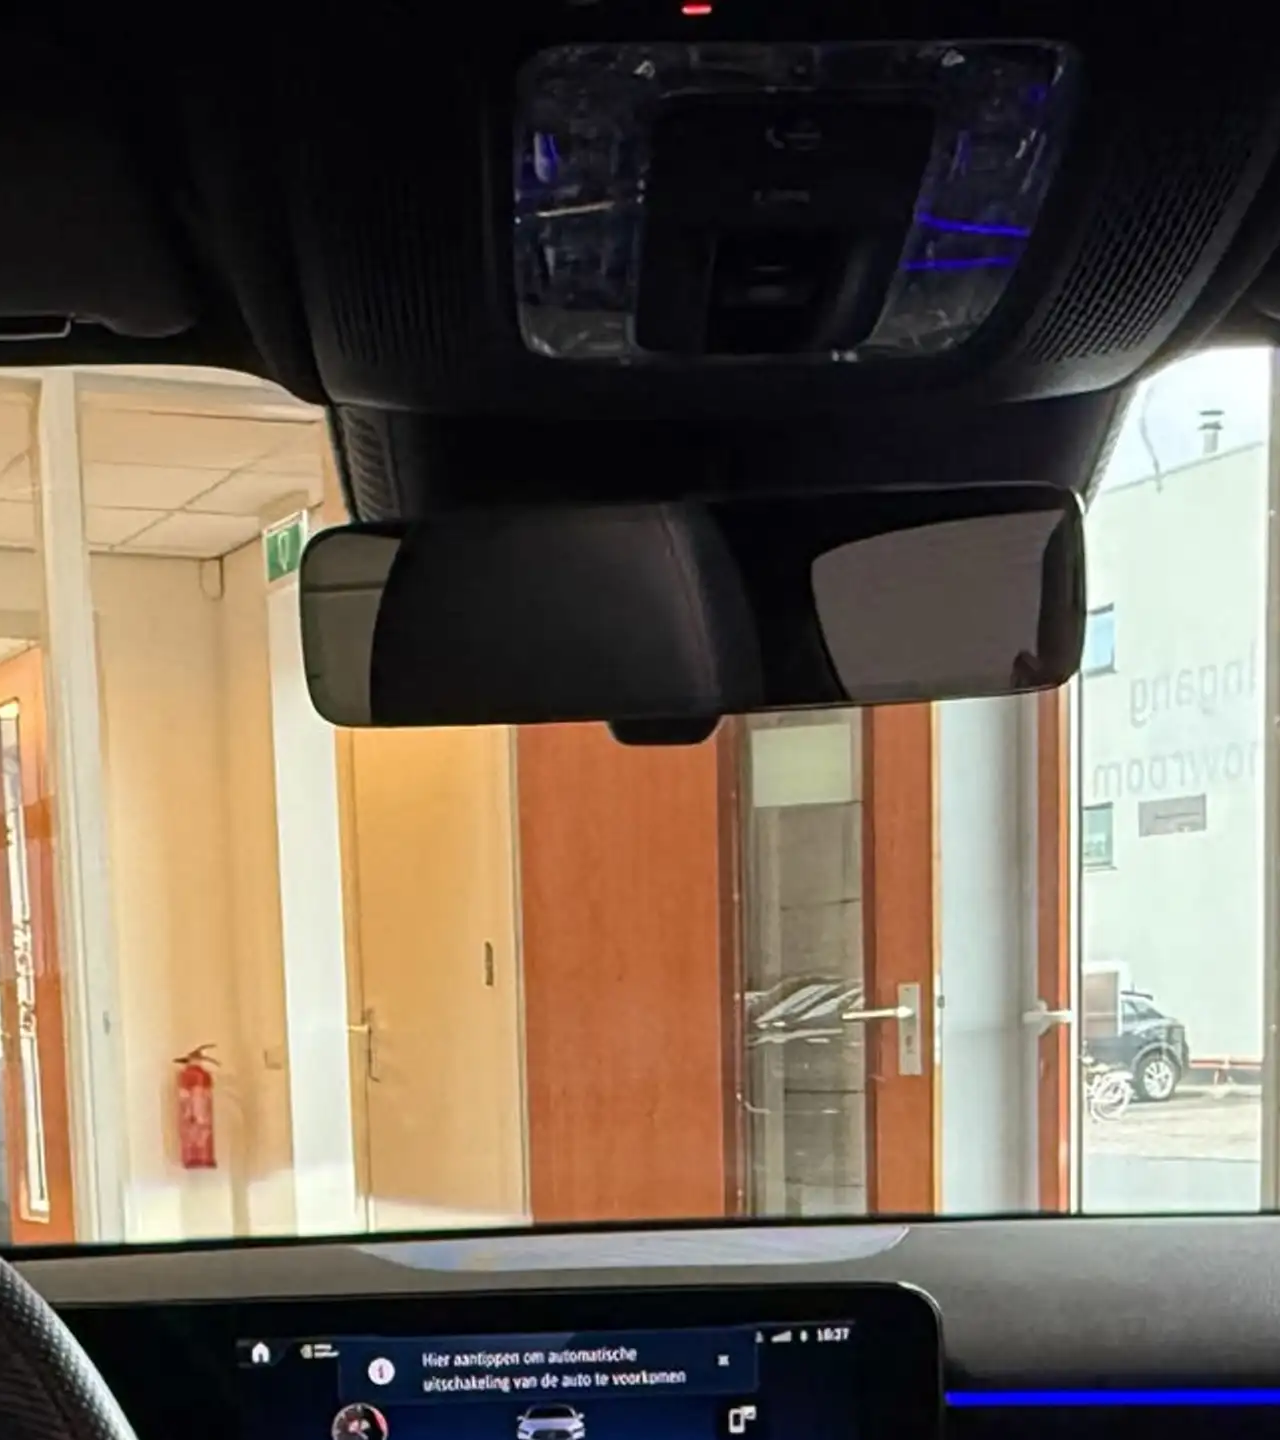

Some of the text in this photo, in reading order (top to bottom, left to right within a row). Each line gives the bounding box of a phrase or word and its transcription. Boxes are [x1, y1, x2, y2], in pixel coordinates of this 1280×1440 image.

[422, 1347, 637, 1369] Hier aantippen om automatische
[423, 1369, 687, 1392] uitschakeling van de auto te voorkomen
